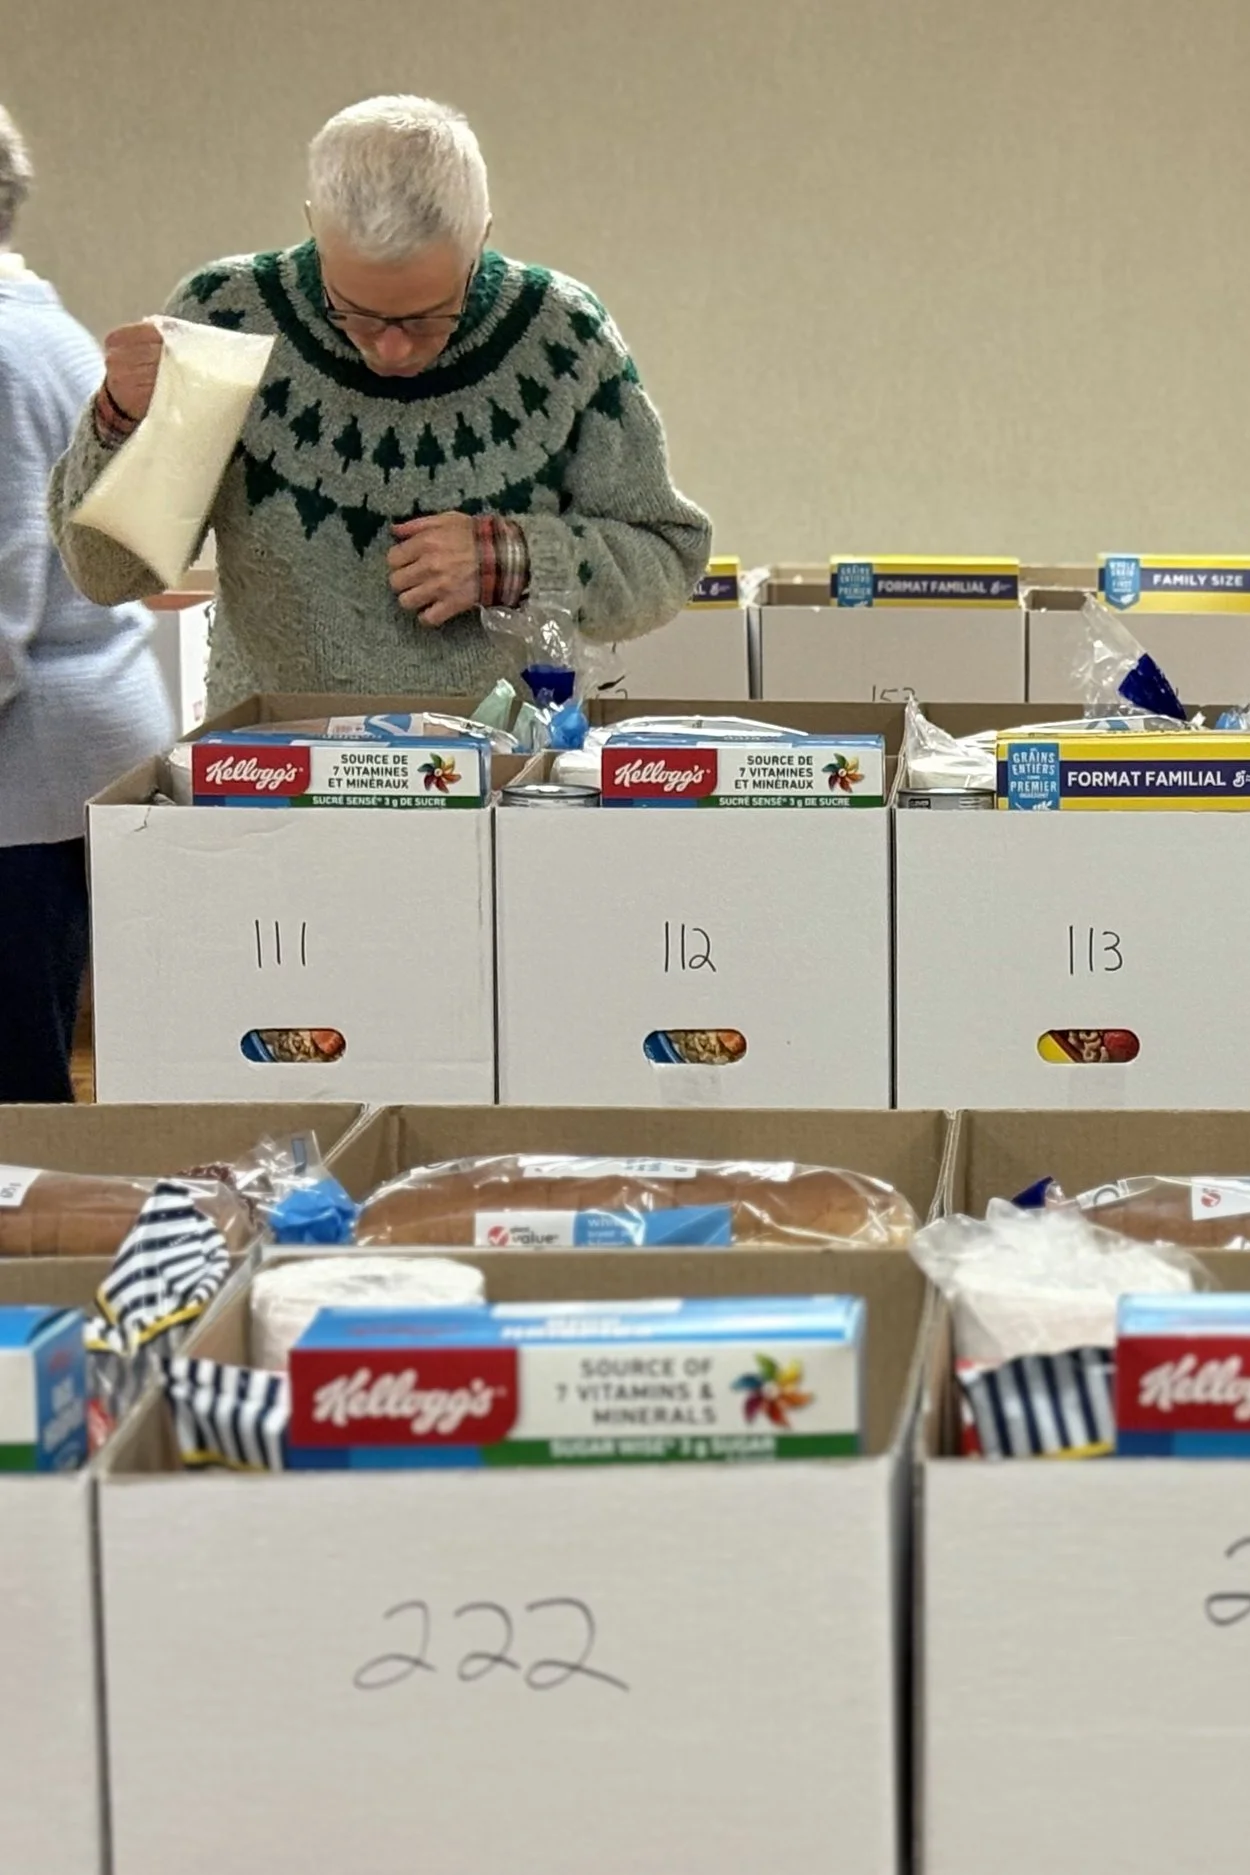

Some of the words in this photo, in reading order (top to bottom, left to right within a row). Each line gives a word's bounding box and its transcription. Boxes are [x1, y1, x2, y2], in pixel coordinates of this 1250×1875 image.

[878, 580, 929, 593] FORMAT
[930, 581, 986, 594] FAMILIAL
[1153, 574, 1207, 587] FAMILY
[1211, 574, 1243, 587] SIZE
[341, 754, 389, 764] SOURCE
[393, 755, 408, 765] DE
[747, 755, 794, 765] SOURCE
[798, 756, 813, 765] DE
[1012, 751, 1056, 763] GRAINS
[206, 756, 297, 790] Kellogg's
[333, 766, 339, 776] 7
[344, 766, 408, 777] VITAMINES
[614, 759, 704, 792] Kellogg's
[739, 768, 745, 777] 7
[750, 768, 813, 777] VITAMINES
[1012, 763, 1056, 776] ENTIERS
[328, 778, 342, 788] ET
[346, 776, 408, 789] MINÉRAUX
[735, 780, 749, 789] ET
[752, 777, 813, 789] MINÉRAUX
[1067, 771, 1140, 787] FORMAT
[1145, 771, 1226, 787] FAMILIAL
[1010, 781, 1057, 792] PREMIER
[400, 797, 413, 806] DE
[805, 797, 817, 806] DE
[255, 920, 307, 968] 111
[665, 921, 717, 972] 112
[1069, 925, 1123, 975] 113
[581, 1358, 675, 1379] SOURCE
[683, 1358, 714, 1378] OF
[556, 1385, 568, 1404] 7
[576, 1382, 691, 1403] VITAMINS
[699, 1381, 715, 1401] &
[314, 1368, 494, 1434] Kellogg's
[592, 1406, 717, 1427] MINERALS
[351, 1596, 630, 1692] 222
